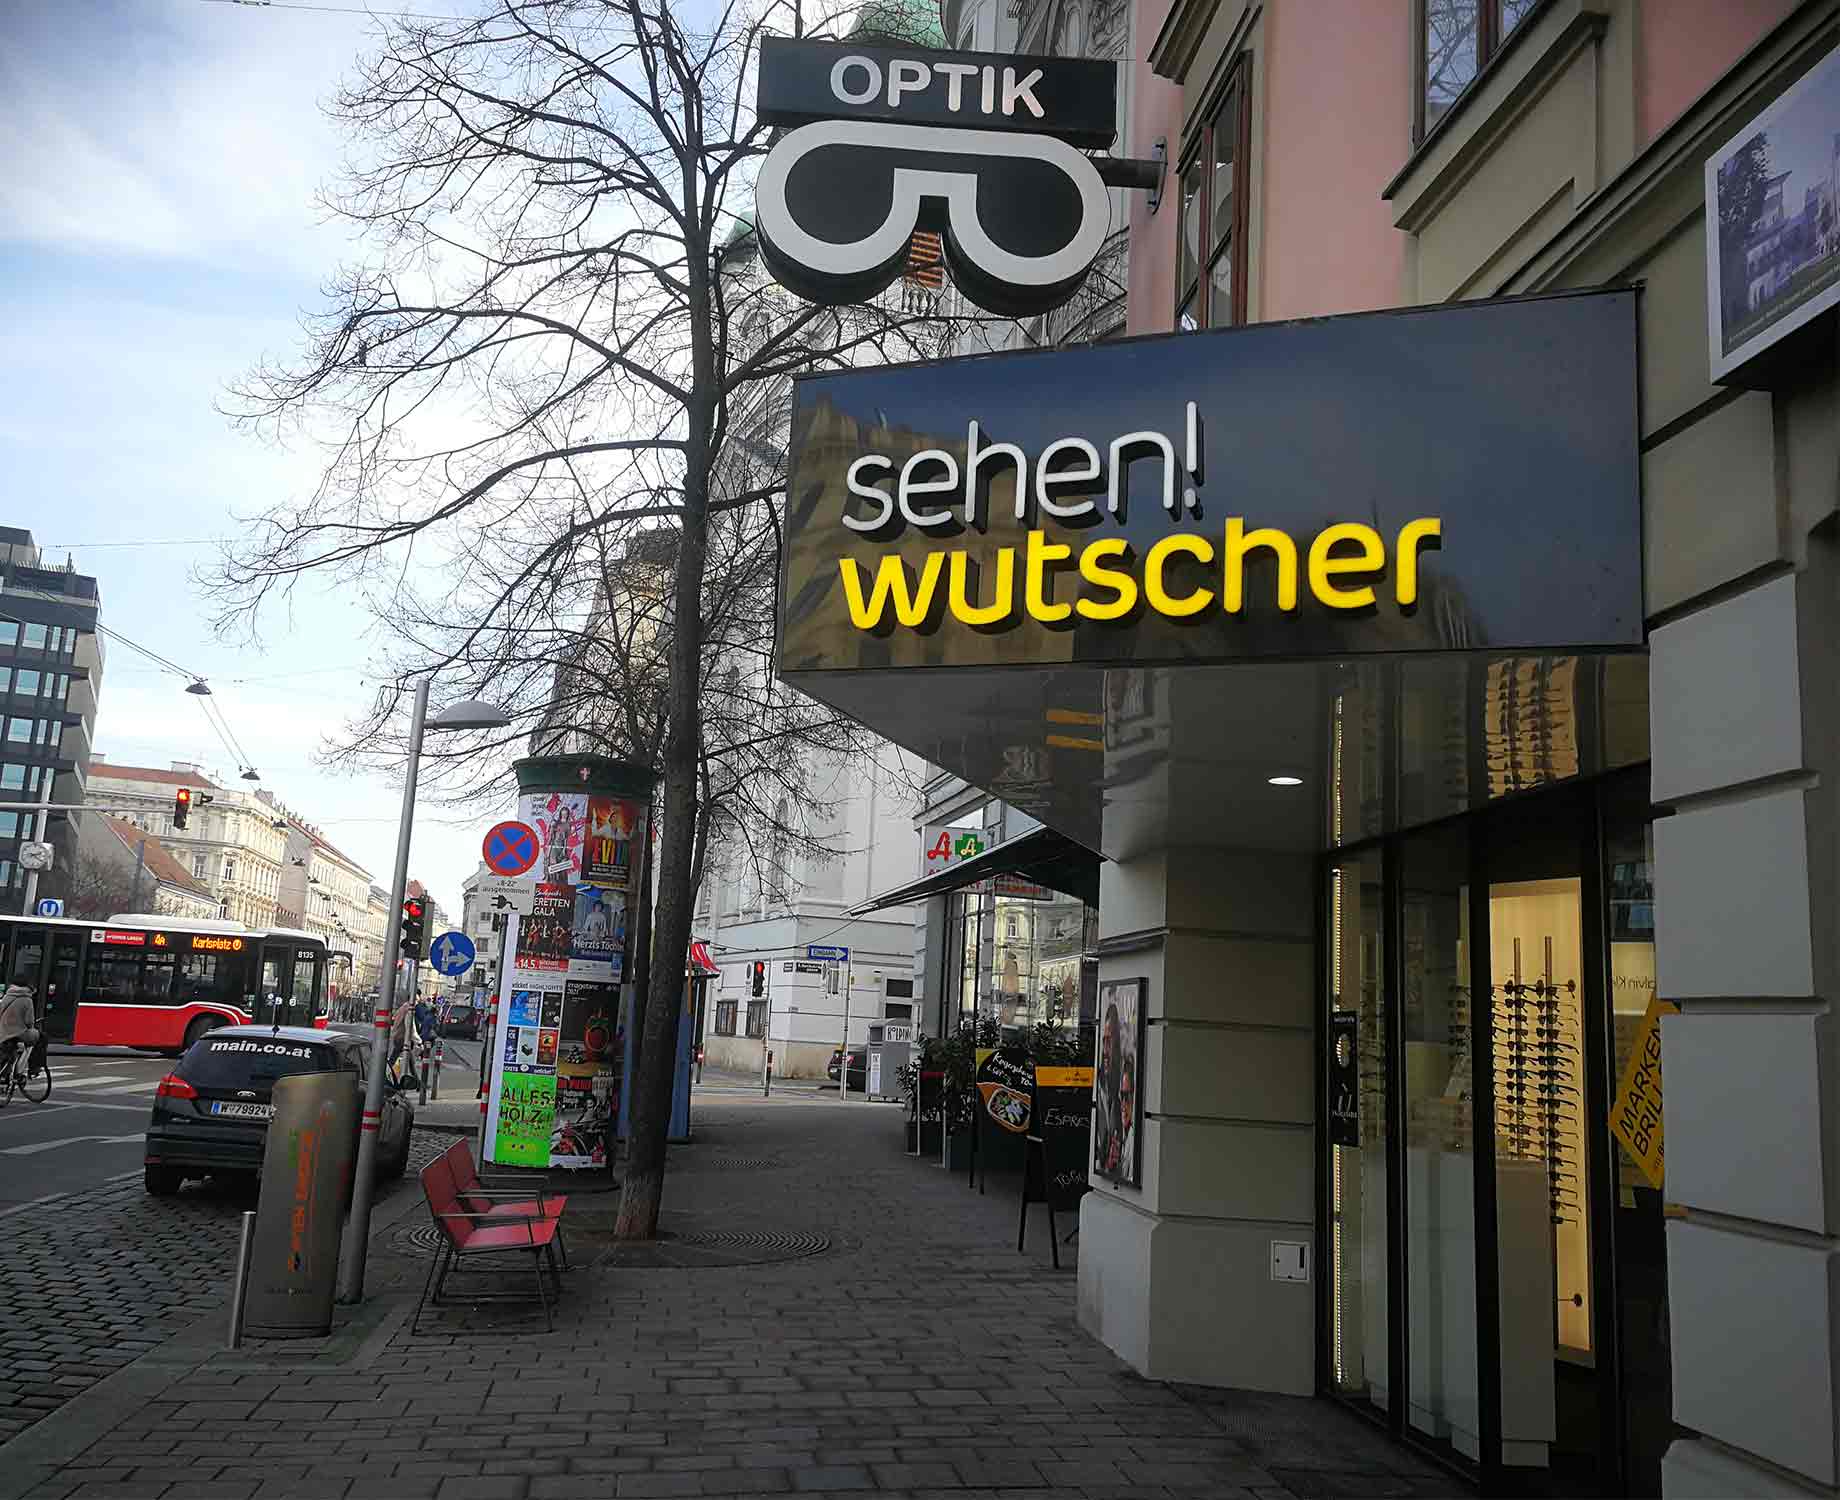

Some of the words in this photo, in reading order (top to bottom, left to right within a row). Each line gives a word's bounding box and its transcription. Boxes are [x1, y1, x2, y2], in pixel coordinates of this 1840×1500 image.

[830, 54, 1045, 118] OPTIK
[842, 400, 1199, 532] sehen!
[839, 516, 1442, 630] wutscher
[534, 907, 556, 917] GALA
[192, 935, 231, 950] Karlsplatz
[298, 951, 314, 959] 8135
[210, 1039, 312, 1059] main.co.at
